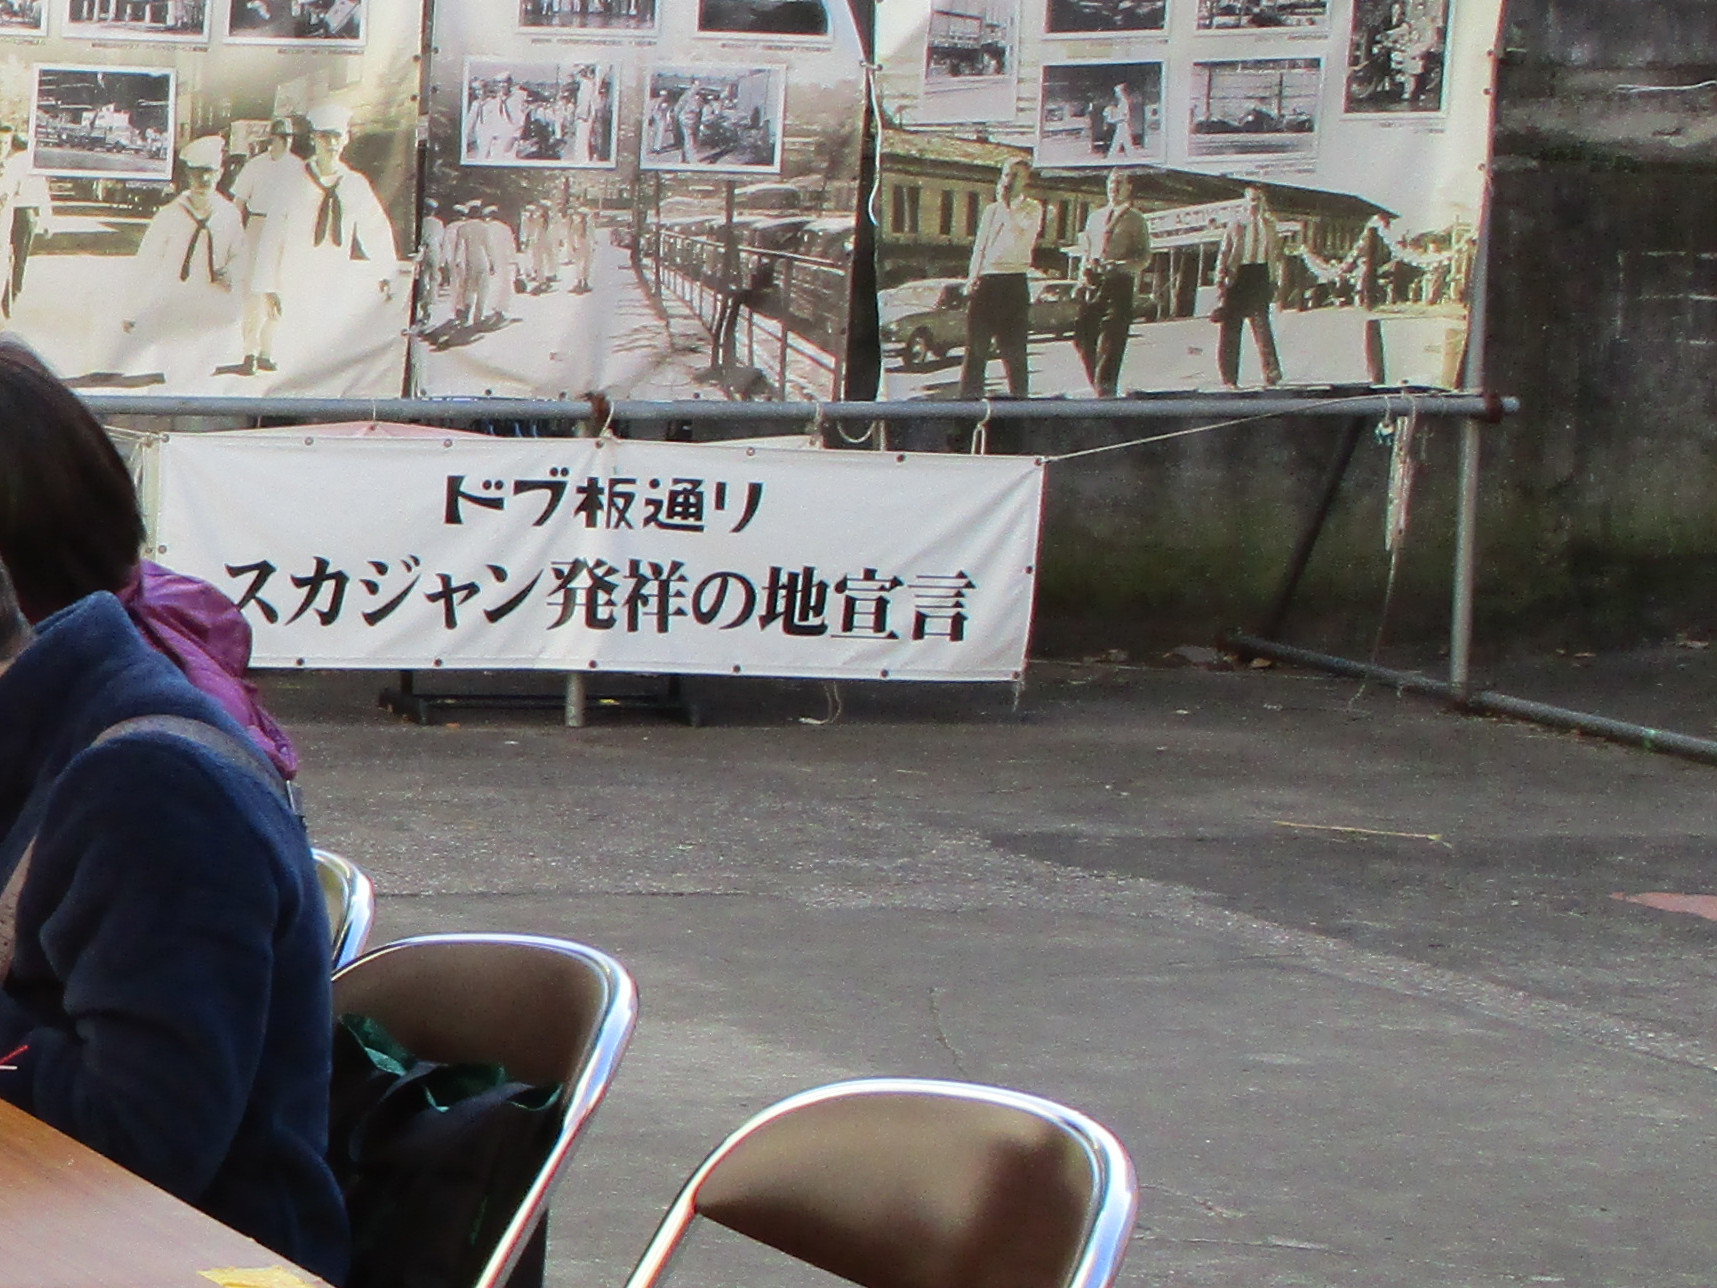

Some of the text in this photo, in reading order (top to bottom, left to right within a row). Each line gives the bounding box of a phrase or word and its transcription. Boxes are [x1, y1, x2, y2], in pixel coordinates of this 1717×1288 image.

[444, 466, 764, 533] ドブ板通り
[224, 553, 977, 642] スカジャン発祥の地宣言
